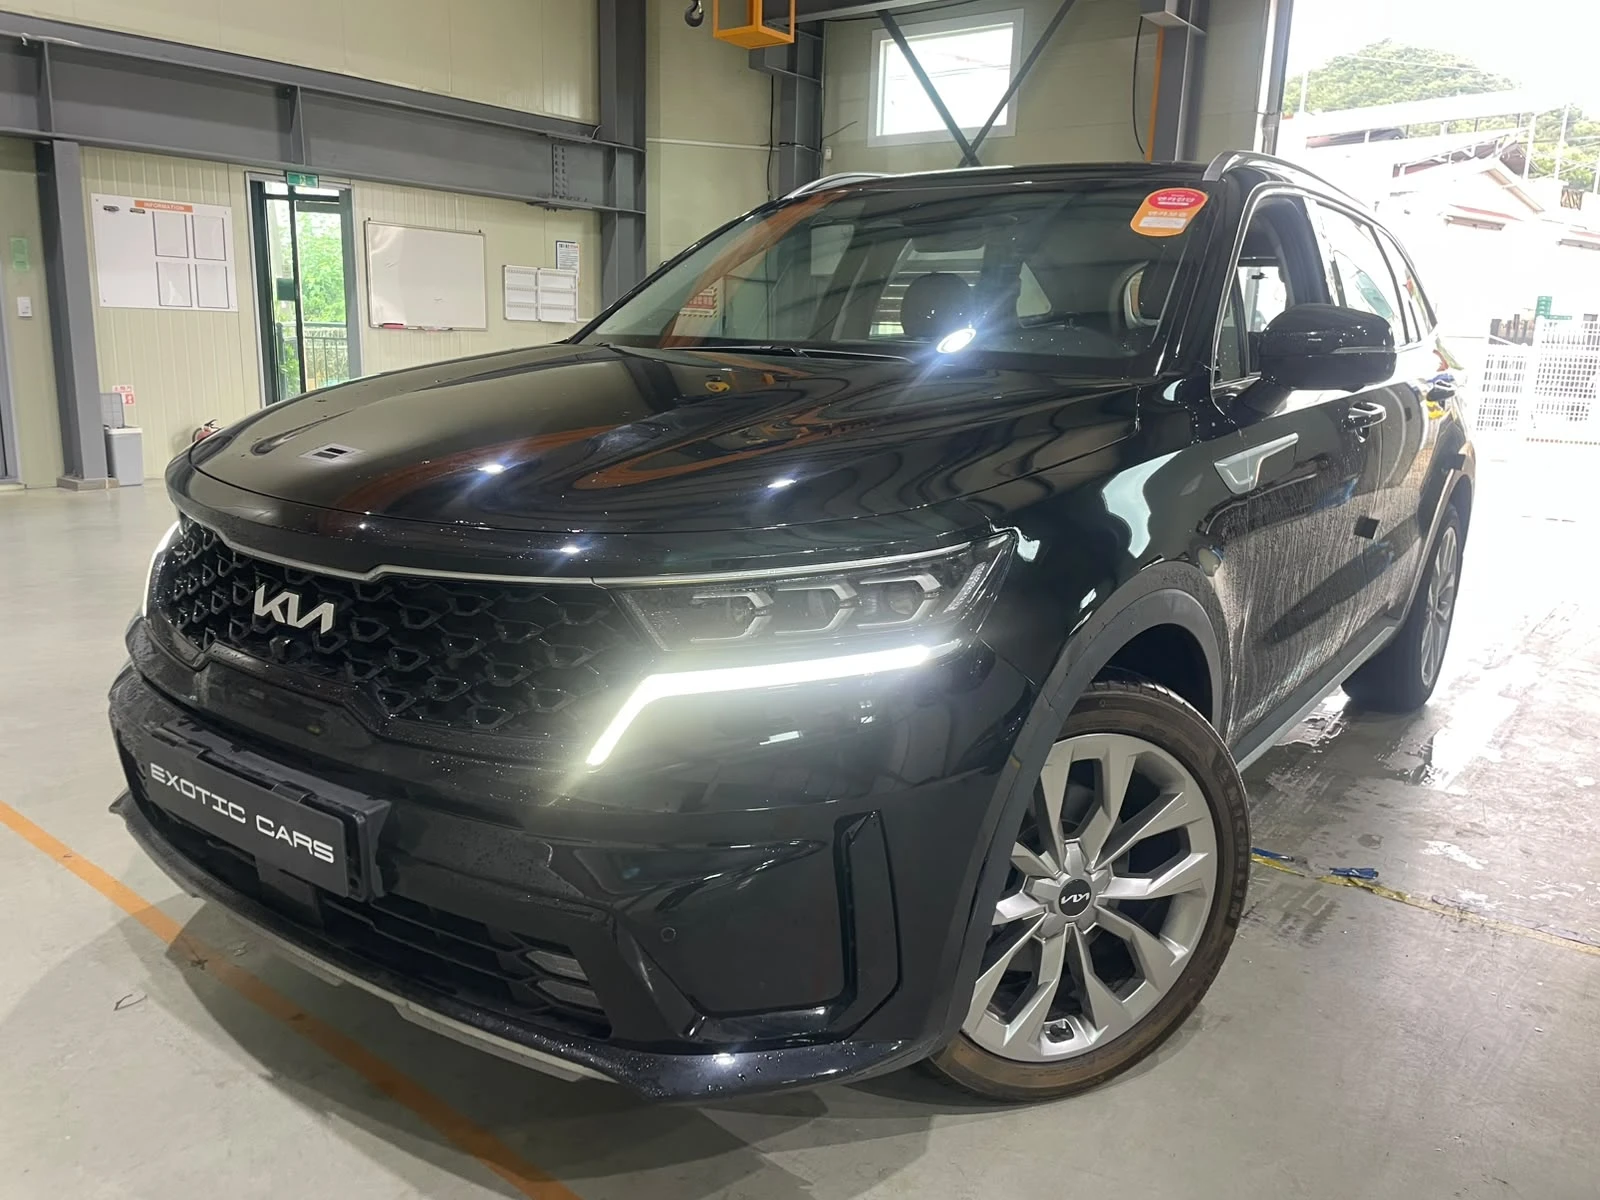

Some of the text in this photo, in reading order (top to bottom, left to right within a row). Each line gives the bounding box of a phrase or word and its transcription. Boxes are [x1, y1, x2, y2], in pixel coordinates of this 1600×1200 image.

[143, 201, 185, 211] INFORMATION
[254, 583, 335, 635] KIA
[150, 762, 335, 864] EXOTIC CARS
